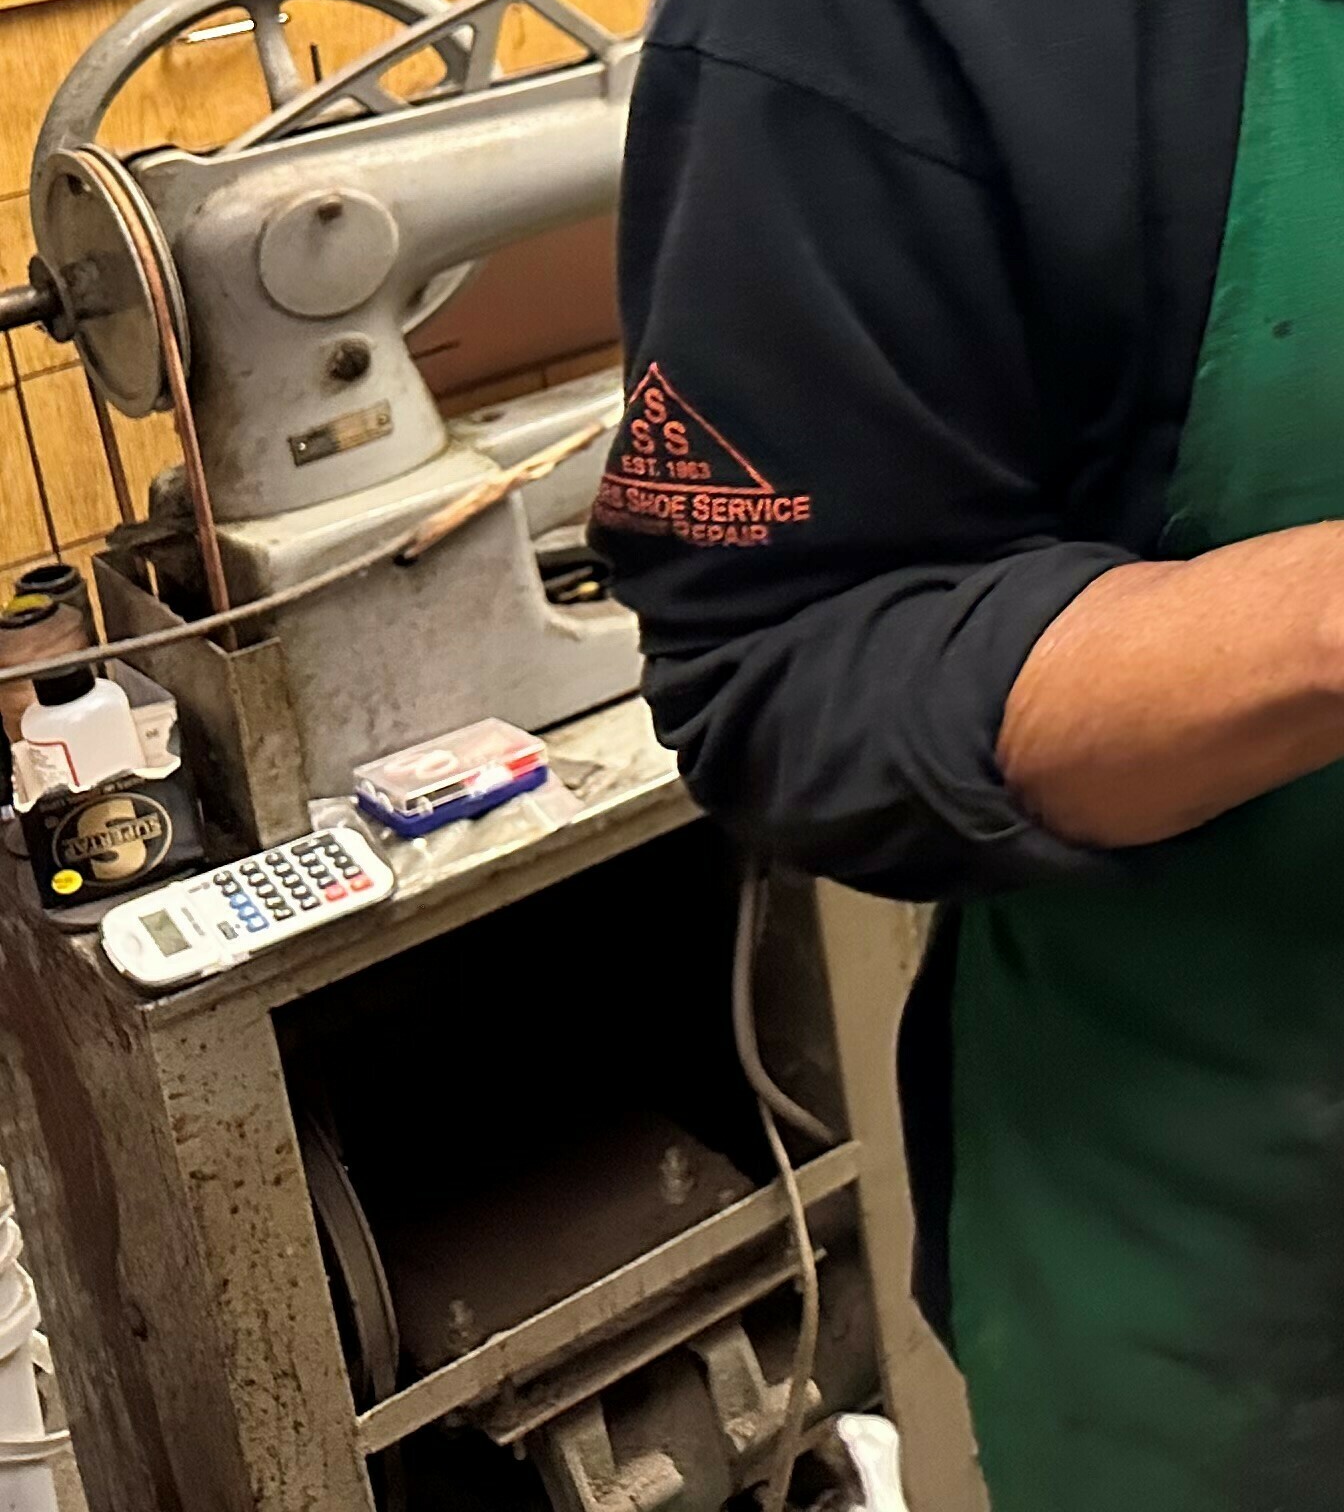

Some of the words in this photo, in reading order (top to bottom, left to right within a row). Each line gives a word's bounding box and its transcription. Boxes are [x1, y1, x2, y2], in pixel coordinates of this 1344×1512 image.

[644, 387, 667, 424] S
[663, 420, 689, 456] S
[691, 493, 811, 523] SERVICE
